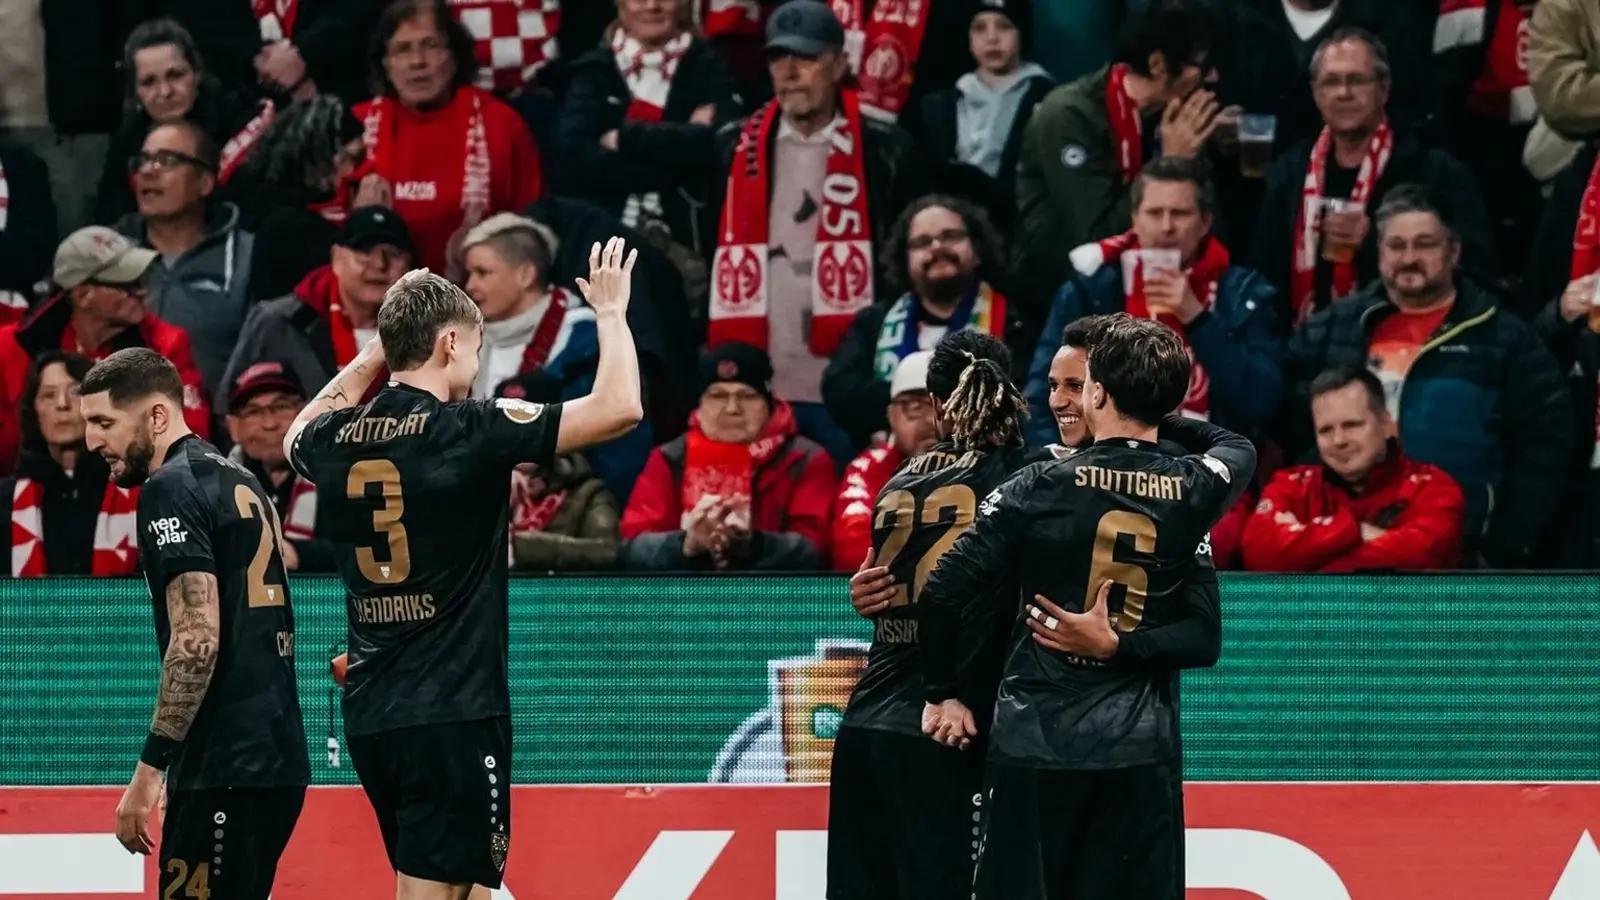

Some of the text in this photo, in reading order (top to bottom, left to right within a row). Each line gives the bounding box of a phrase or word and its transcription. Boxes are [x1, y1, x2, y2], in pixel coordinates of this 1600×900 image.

[822, 173, 861, 236] 05
[346, 458, 411, 585] 3
[1074, 465, 1184, 501] STUTTGART
[234, 483, 286, 609] 2
[872, 483, 977, 608] 22
[1082, 509, 1158, 633] 6
[352, 593, 436, 623] HENDRIKS
[163, 857, 212, 900] 24
